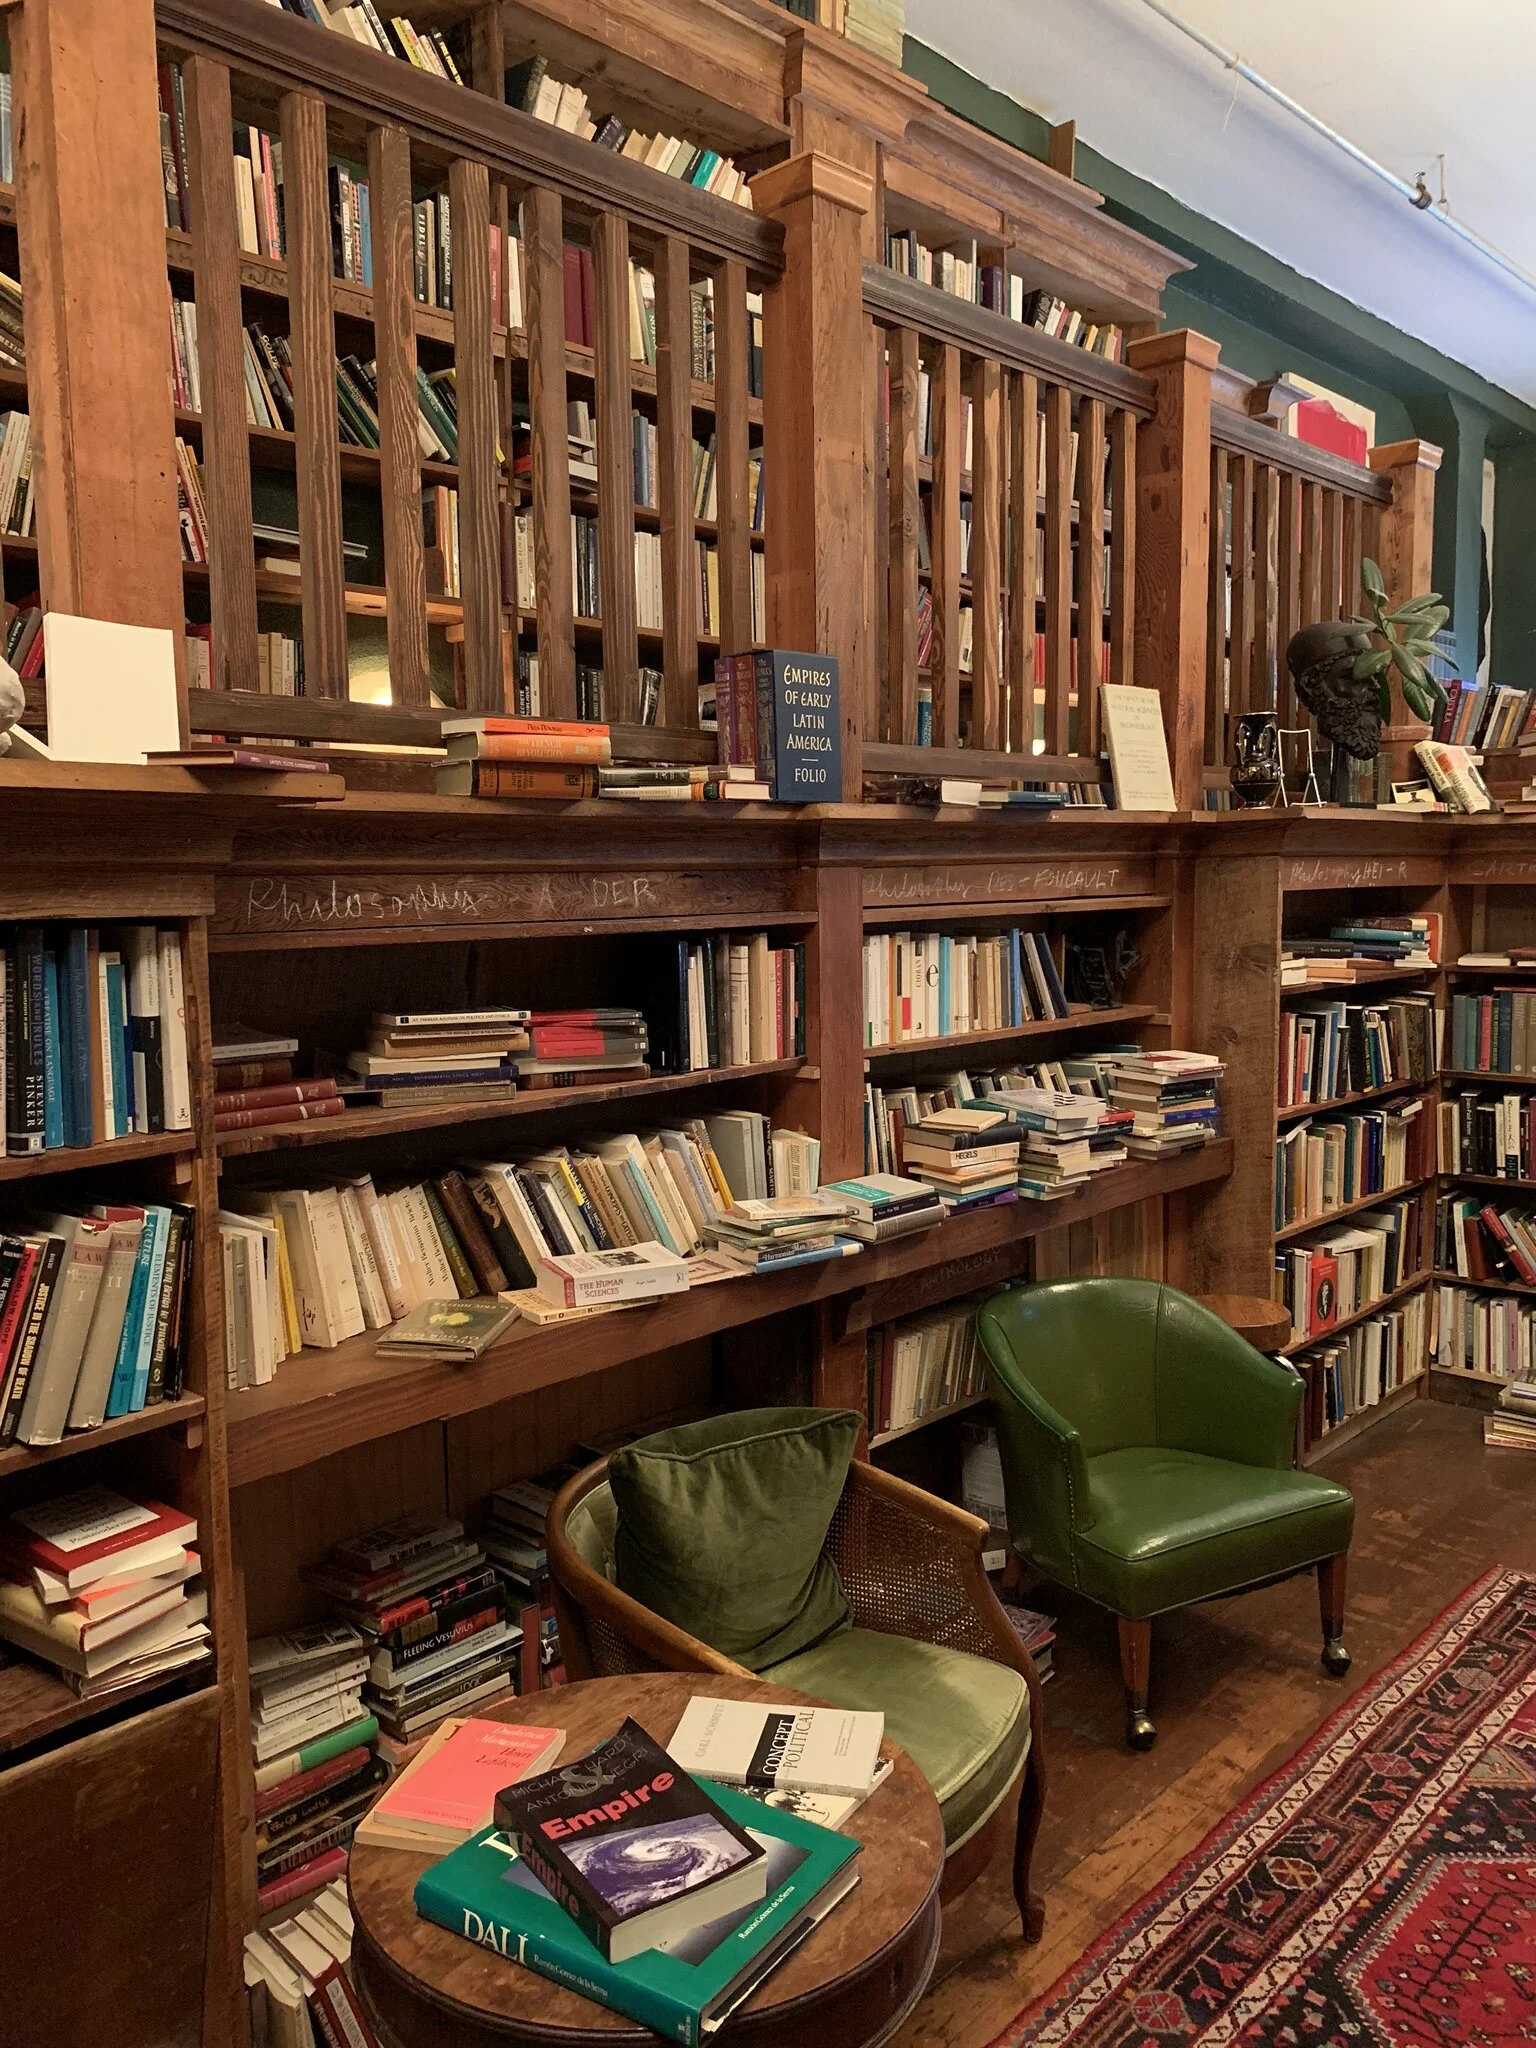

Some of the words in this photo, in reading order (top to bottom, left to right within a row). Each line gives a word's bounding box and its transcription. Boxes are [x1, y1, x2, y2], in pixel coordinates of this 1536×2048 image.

[444, 55, 460, 77] FROM
[180, 158, 192, 189] CUBA
[416, 213, 428, 246] FIDEL
[259, 333, 282, 371] GOLPE
[784, 664, 831, 687] EMPIRES
[785, 690, 798, 706] OF
[800, 689, 831, 708] EARLY
[793, 713, 825, 729] LATIN
[786, 734, 832, 752] AMERICA
[795, 767, 827, 783] FOLIO
[593, 877, 658, 909] DER
[1033, 868, 1120, 890] FOUCAULT
[29, 954, 44, 999] WORDS
[42, 995, 51, 1037] TREATISE
[32, 1025, 44, 1066] RULES
[44, 1053, 55, 1104] LANGUAGE
[24, 1075, 37, 1127] PINKER
[34, 1074, 46, 1126] STEVEN
[602, 1185, 624, 1216] CONCEPTS
[425, 1221, 443, 1257] Benjamin
[591, 1212, 609, 1238] MICHAEL
[73, 1251, 104, 1263] LAW
[359, 1233, 377, 1273] BENJAMIN
[411, 1224, 429, 1261] Benjamin
[19, 1251, 32, 1272] THE
[149, 1253, 163, 1291] ELEMENTS
[423, 1261, 437, 1286] Walter
[436, 1257, 450, 1282] Walter
[8, 1274, 25, 1315] HOLLOW
[33, 1282, 50, 1312] JUSTICE
[107, 1275, 122, 1288] II
[159, 1280, 174, 1308] Berlin
[578, 1281, 595, 1292] THE
[595, 1276, 624, 1293] HUMAN
[584, 1285, 620, 1302] SCIENCES
[148, 1291, 158, 1305] OF
[28, 1320, 40, 1336] THE
[31, 1311, 43, 1322] IN
[142, 1306, 156, 1347] JUSTICE
[0, 1319, 13, 1346] HOPE
[152, 1320, 169, 1363] Jerusalem
[18, 1334, 37, 1367] SHADOW
[17, 1366, 28, 1377] OF
[11, 1376, 26, 1401] DEATH
[401, 1637, 436, 1659] FLEEING
[434, 1621, 476, 1645] VESUVIUS
[458, 1674, 486, 1693] LOGIC
[762, 1719, 794, 1776] CONCEPT
[782, 1710, 815, 1770] POLITICAL
[512, 1767, 580, 1798] MICHAEL
[589, 1731, 636, 1770] HARDT
[527, 1779, 599, 1812] ANTONIO
[604, 1748, 648, 1781] NEGRI
[540, 1771, 675, 1840] Empire
[521, 1832, 579, 1917] Empire
[738, 1921, 757, 1940] Ramón
[755, 1906, 774, 1929] Gómez
[781, 1885, 796, 1901] Serna
[463, 1908, 529, 1966] DALÍ
